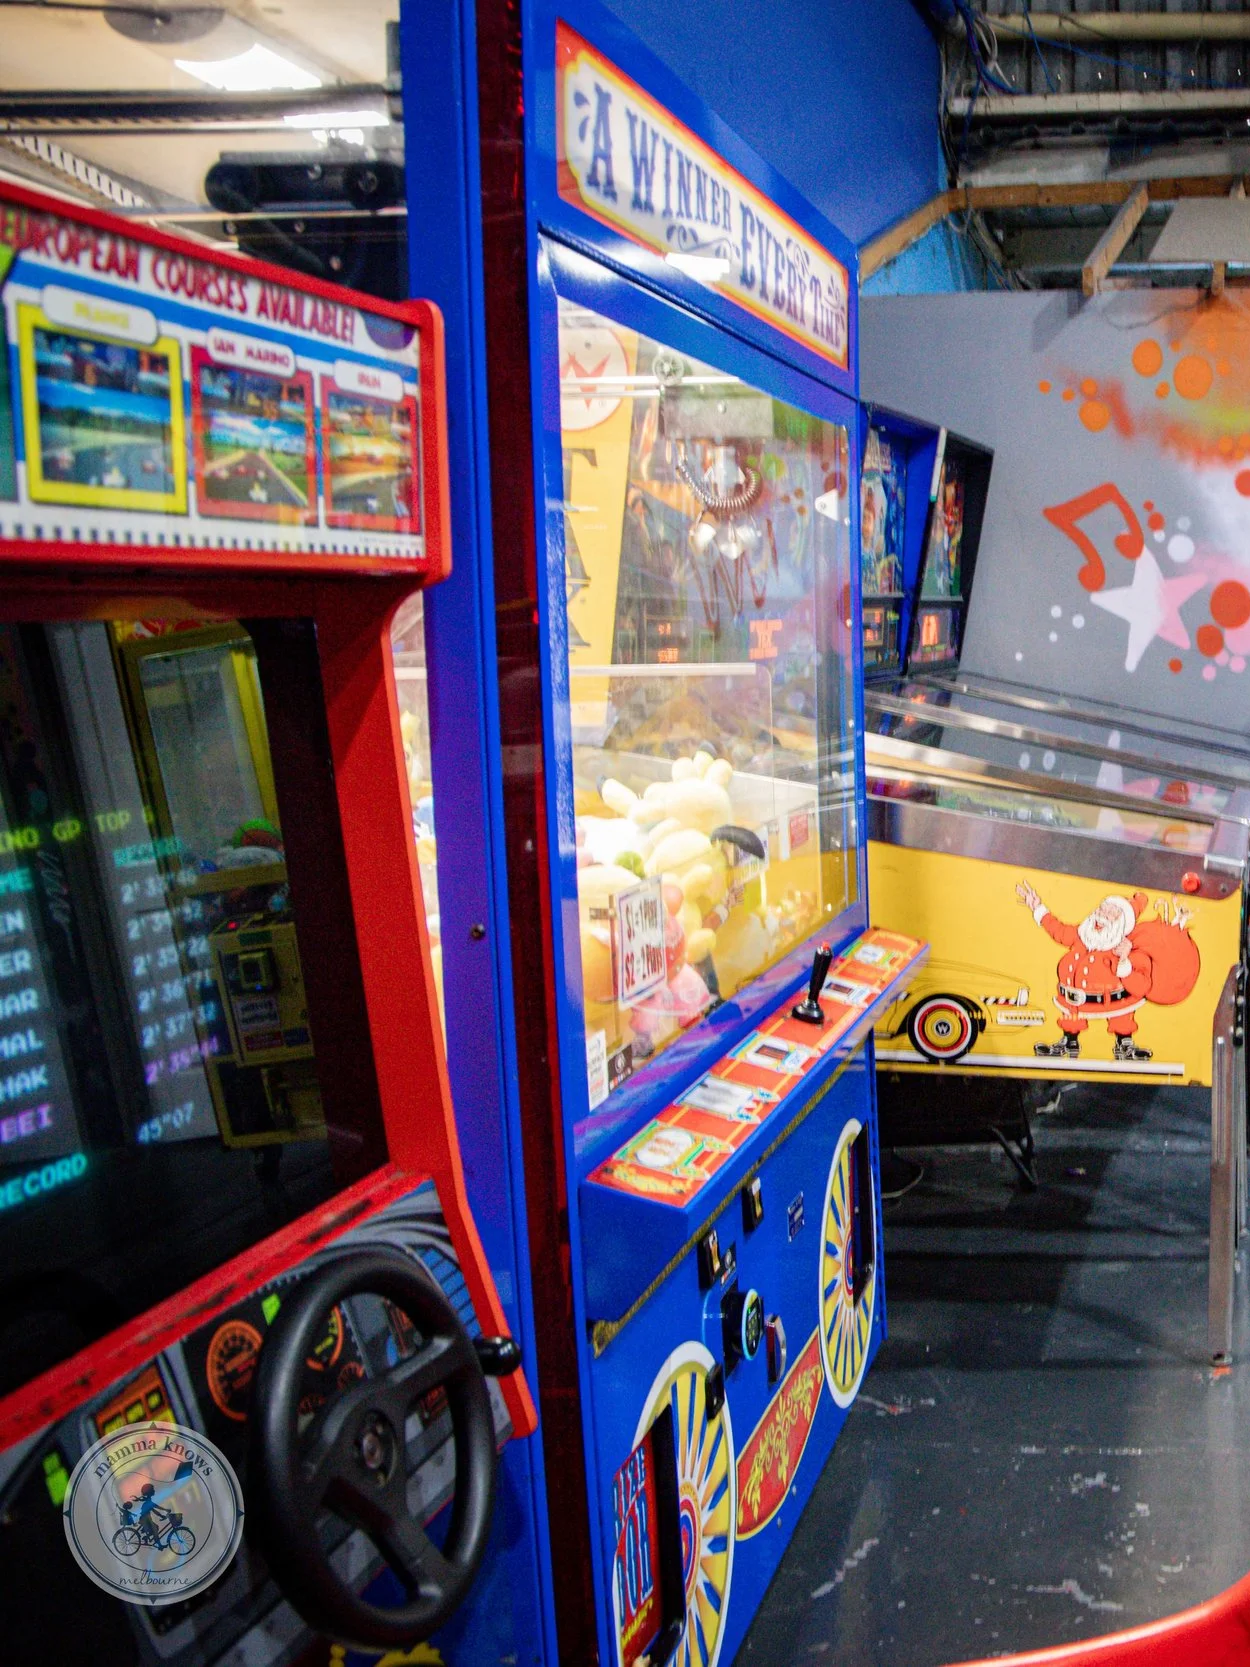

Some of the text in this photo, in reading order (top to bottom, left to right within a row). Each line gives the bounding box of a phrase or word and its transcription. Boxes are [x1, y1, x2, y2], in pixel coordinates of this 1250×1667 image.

[0, 206, 356, 344] EUROPEAN COURSES AVAILABLE!
[587, 82, 846, 347] A WINNER EVERY TIME
[95, 809, 130, 833] TOP
